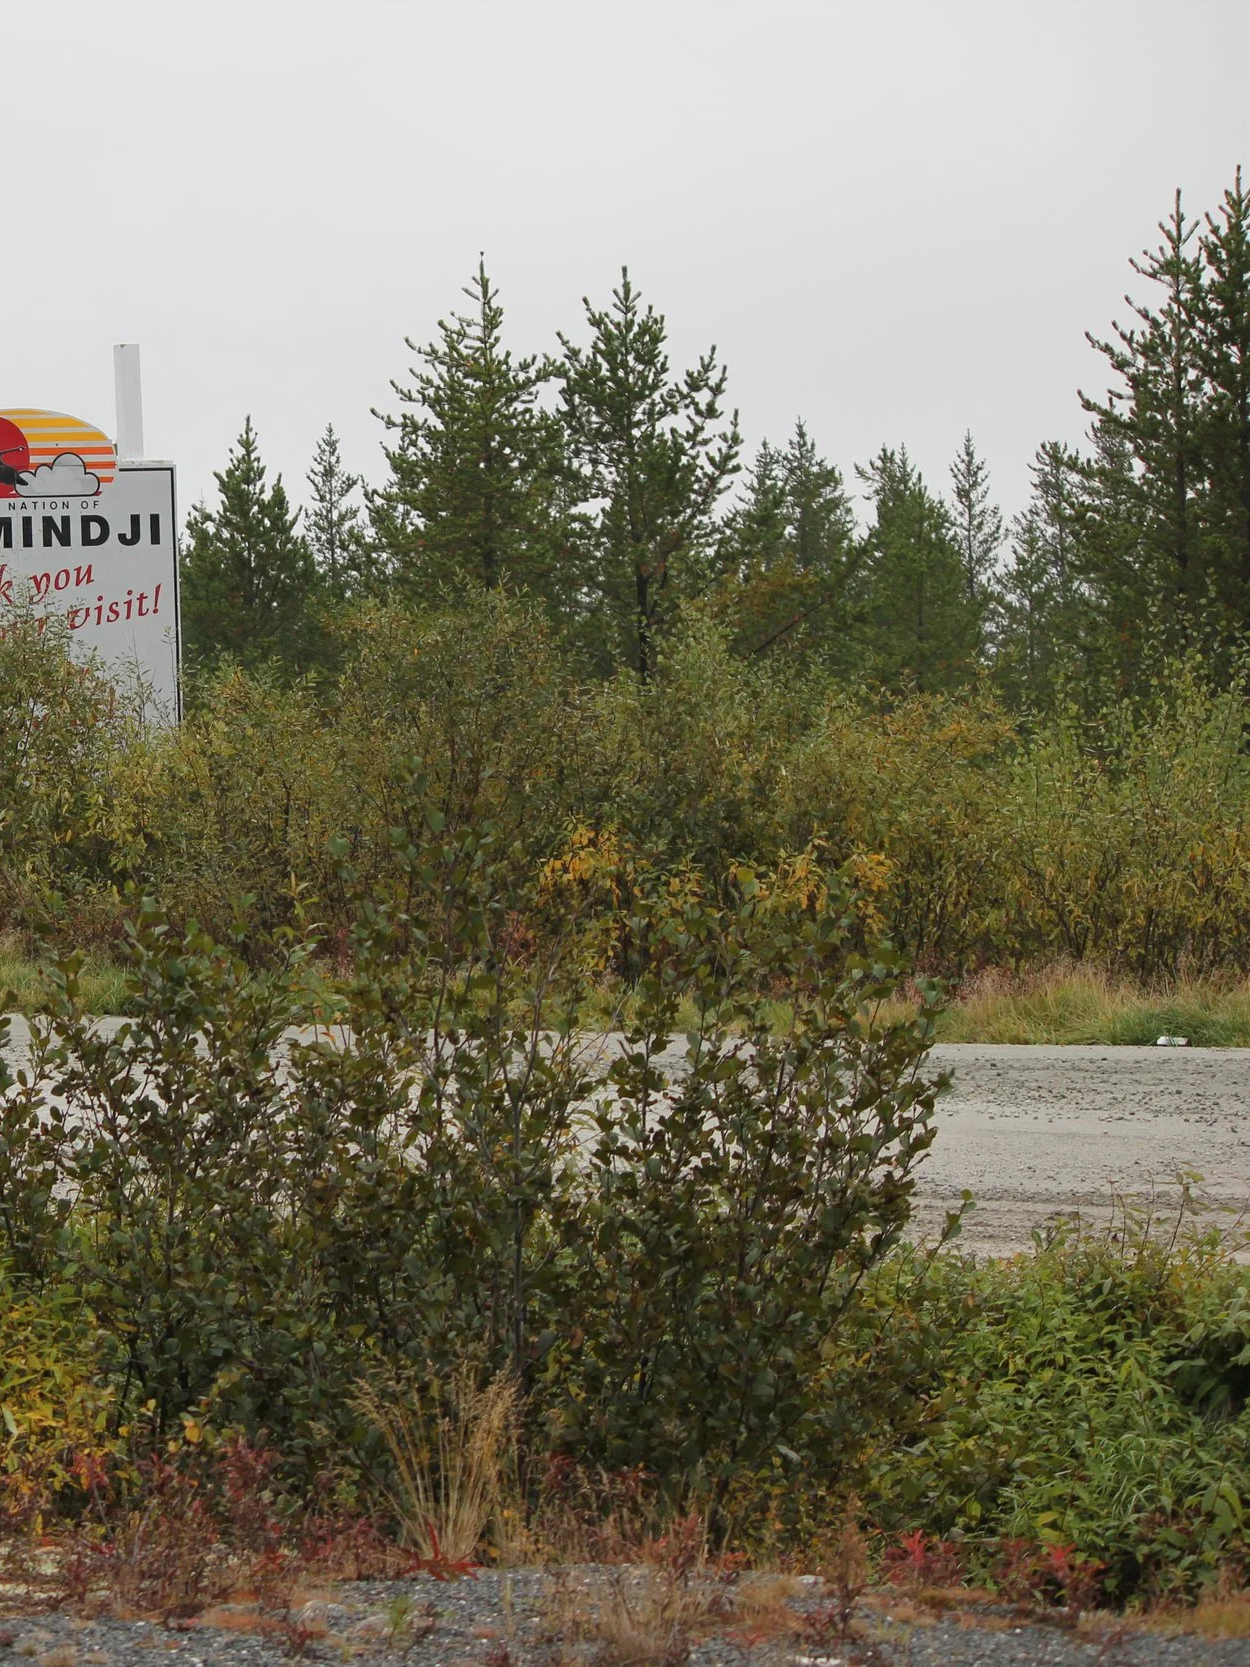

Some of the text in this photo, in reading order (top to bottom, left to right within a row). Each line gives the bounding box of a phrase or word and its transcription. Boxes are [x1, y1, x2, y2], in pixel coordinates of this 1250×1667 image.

[8, 501, 70, 511] NATION
[80, 500, 100, 510] OF
[29, 563, 95, 605] you
[67, 583, 163, 631] visit!
